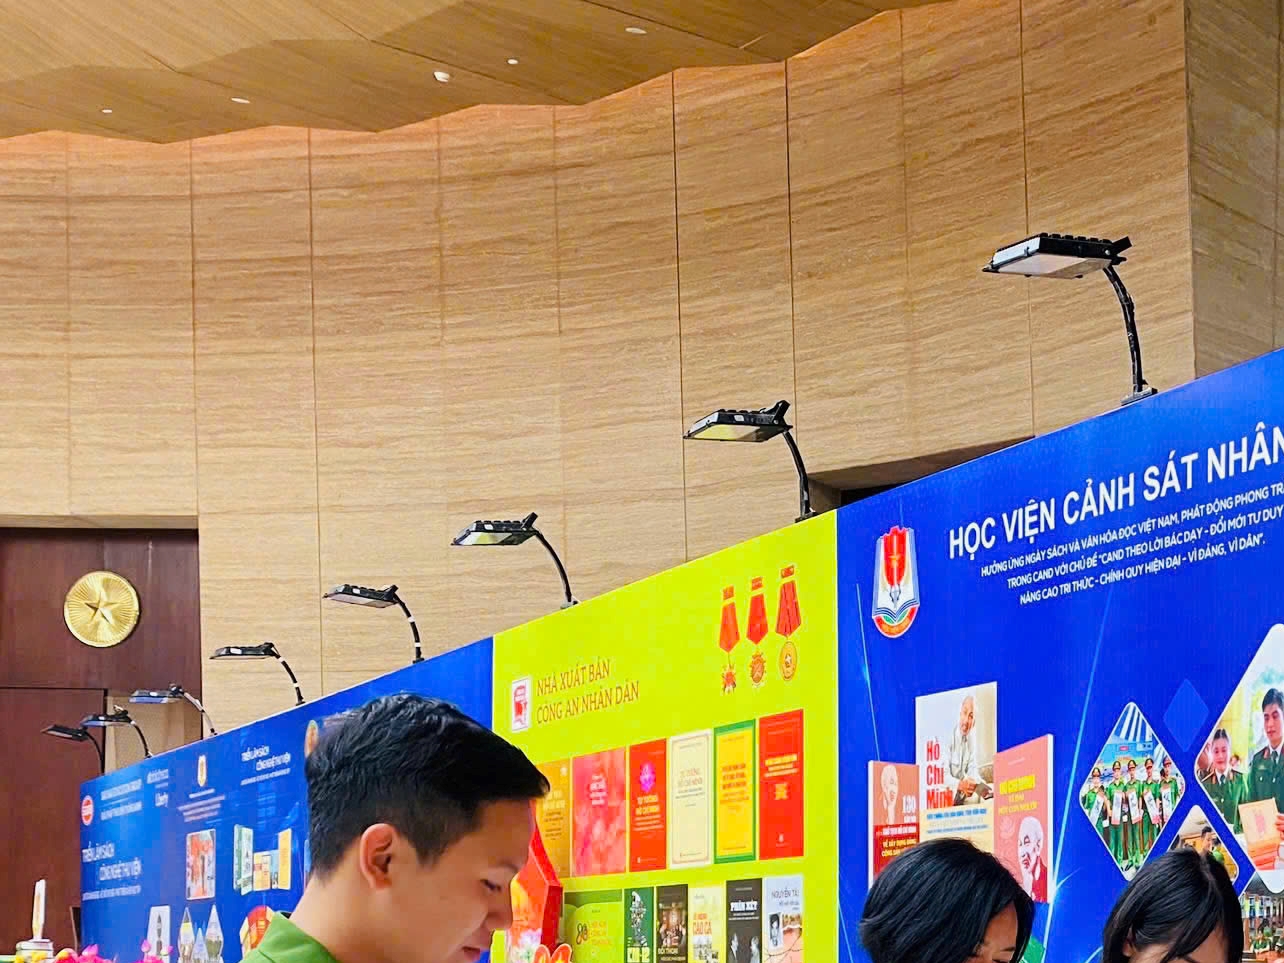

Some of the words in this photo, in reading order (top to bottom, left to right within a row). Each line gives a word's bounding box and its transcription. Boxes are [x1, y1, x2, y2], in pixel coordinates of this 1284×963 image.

[949, 517, 996, 560] HỌC
[1002, 498, 1055, 544] VIỆN
[1063, 472, 1135, 528] CẢNH
[1143, 450, 1199, 501] SÁT
[1025, 549, 1046, 566] NGÀY
[1047, 542, 1068, 559] SÁCH
[1119, 523, 1137, 541] ĐỌC
[1138, 518, 1156, 535] VIỆT
[1157, 513, 1180, 529] NAM,
[1181, 503, 1205, 523] PHÁT
[1206, 497, 1233, 516] ĐỘNG
[1234, 486, 1269, 507] PHONG
[1007, 573, 1034, 589] TRONG
[1034, 568, 1055, 582] CAND
[1125, 542, 1147, 558] THEO
[1164, 532, 1183, 549] BÁC
[1184, 526, 1203, 545] DẠY
[1210, 516, 1226, 537] ĐỔI
[1227, 512, 1246, 532] MỚI
[1248, 510, 1262, 527] TƯ
[1262, 504, 1284, 523] DUY
[1019, 589, 1041, 606] NÂNG
[1042, 585, 1058, 600] CAO
[1072, 576, 1094, 593] THỨC
[1100, 568, 1125, 585] CHÍNH
[1125, 564, 1145, 580] QUY
[1146, 558, 1165, 576] HIỆN
[1166, 553, 1181, 571] ĐẠI
[1198, 542, 1227, 561] ĐẢNG,
[536, 704, 562, 724] CÔNG
[565, 697, 580, 717] AN
[581, 687, 612, 715] NHÂN
[615, 679, 640, 705] DÂN
[537, 672, 558, 697] NHÀ
[560, 664, 587, 691] XUẤT
[589, 657, 611, 682] BẢN
[926, 736, 940, 762] Hồ
[926, 787, 953, 810] Minh
